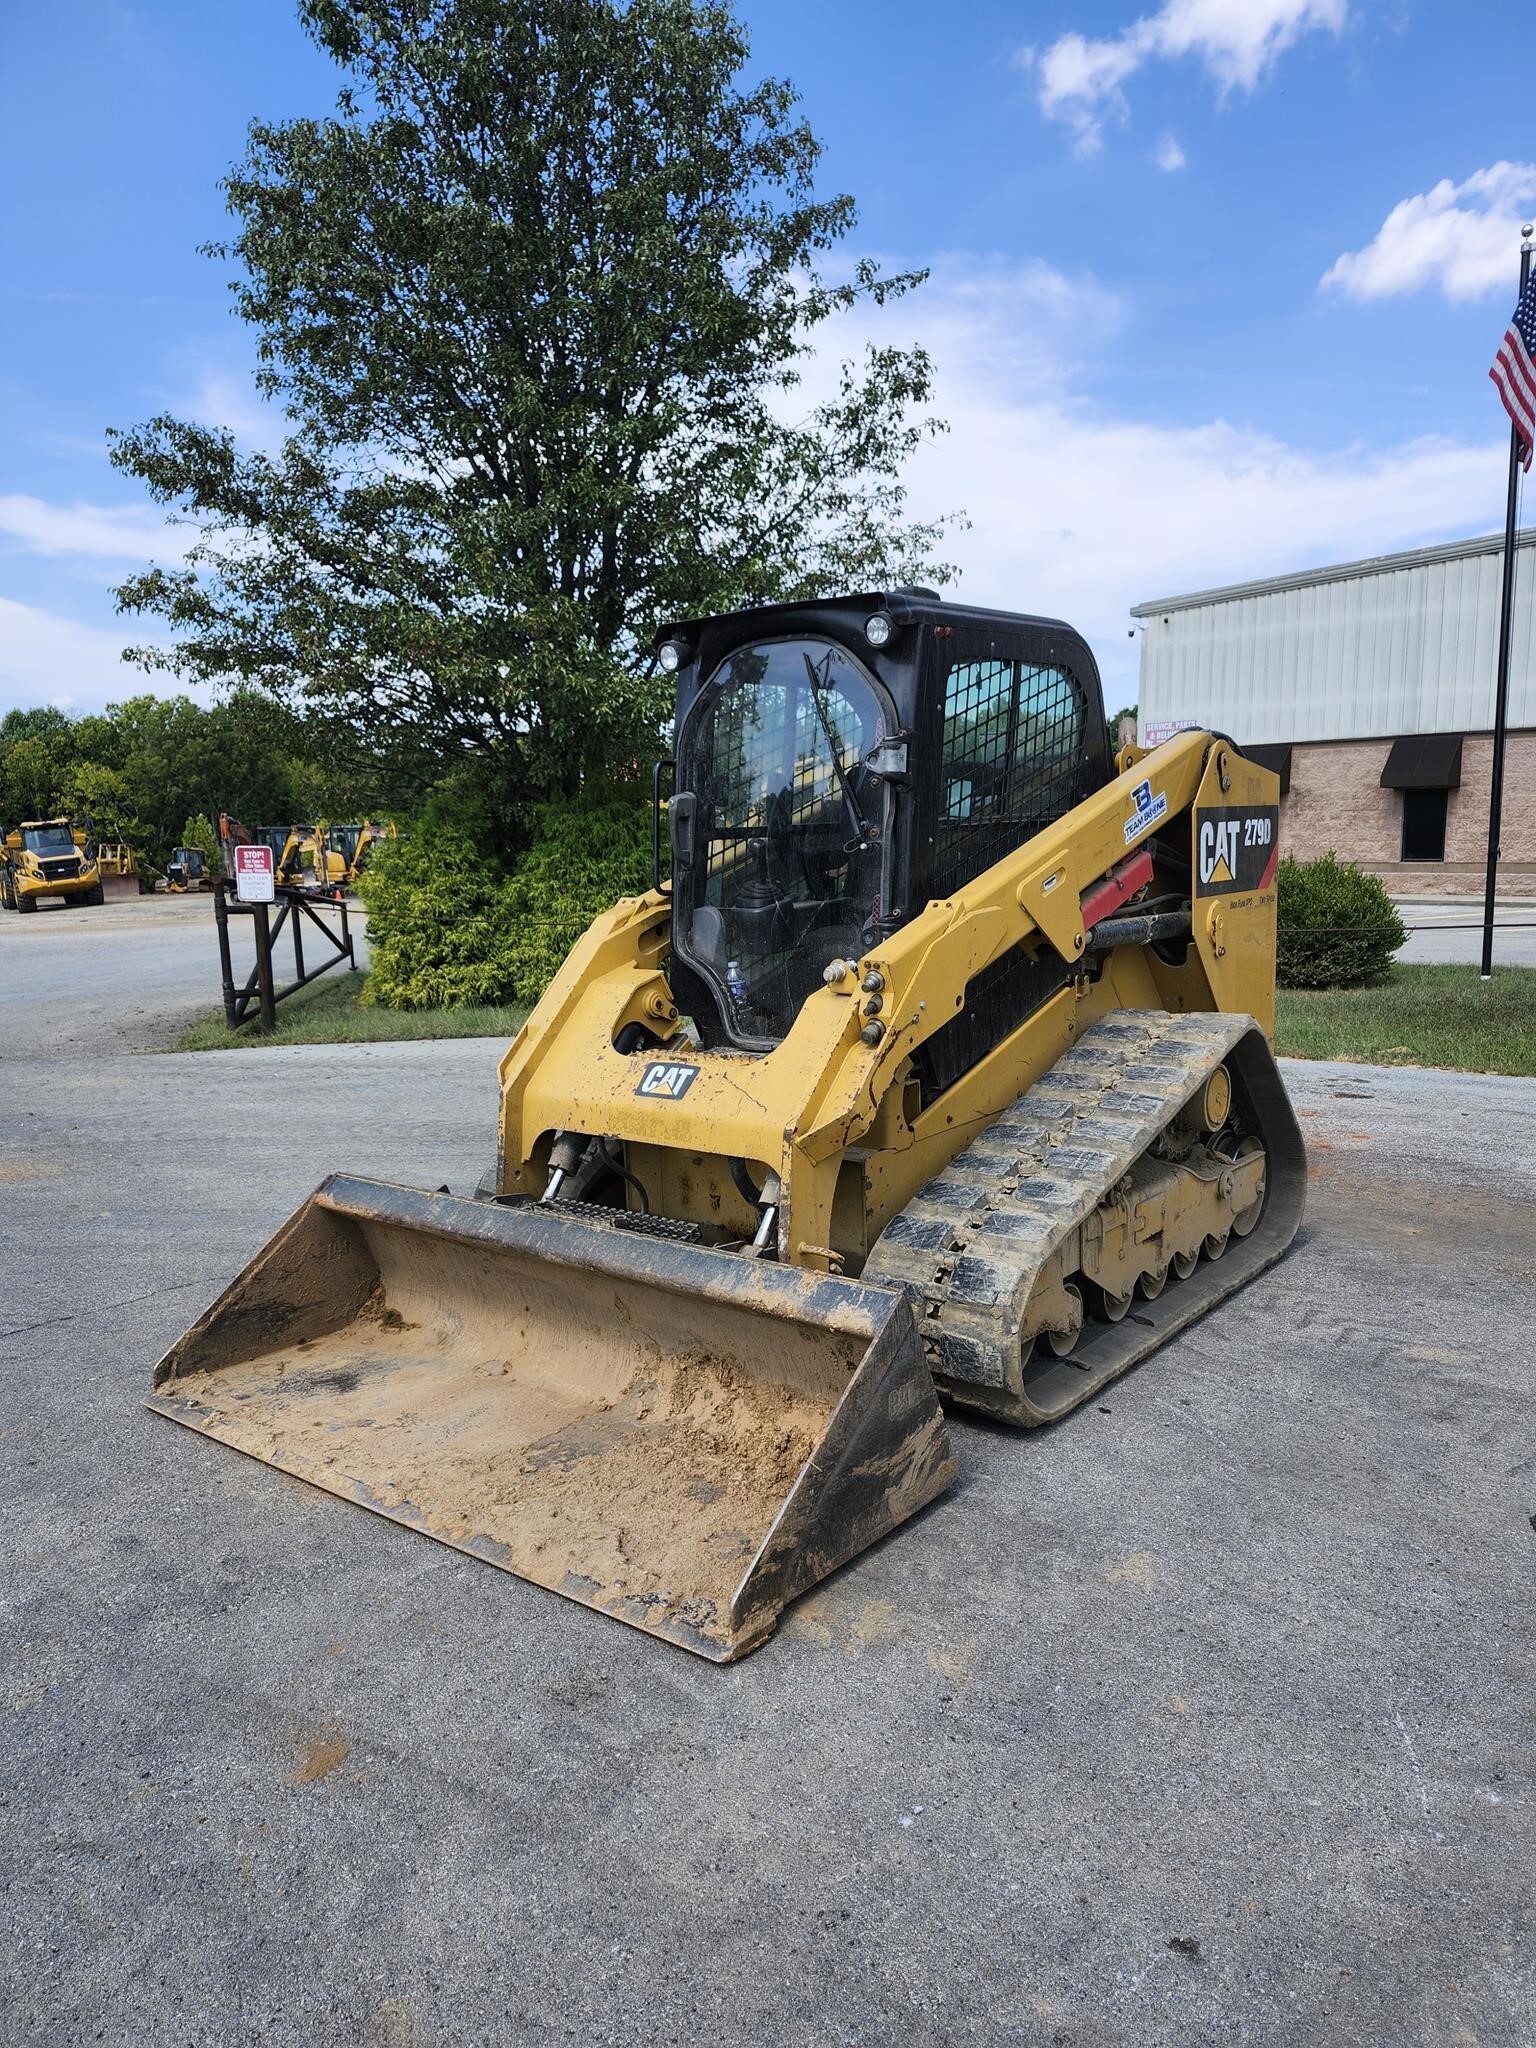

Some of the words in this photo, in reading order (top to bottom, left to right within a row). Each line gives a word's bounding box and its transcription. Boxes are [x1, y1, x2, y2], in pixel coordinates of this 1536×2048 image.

[1125, 816, 1145, 837] TEAM
[243, 851, 265, 859] STOP!
[1200, 821, 1240, 884] CAT
[1244, 818, 1271, 847] 279D
[641, 1065, 695, 1096] CAT
